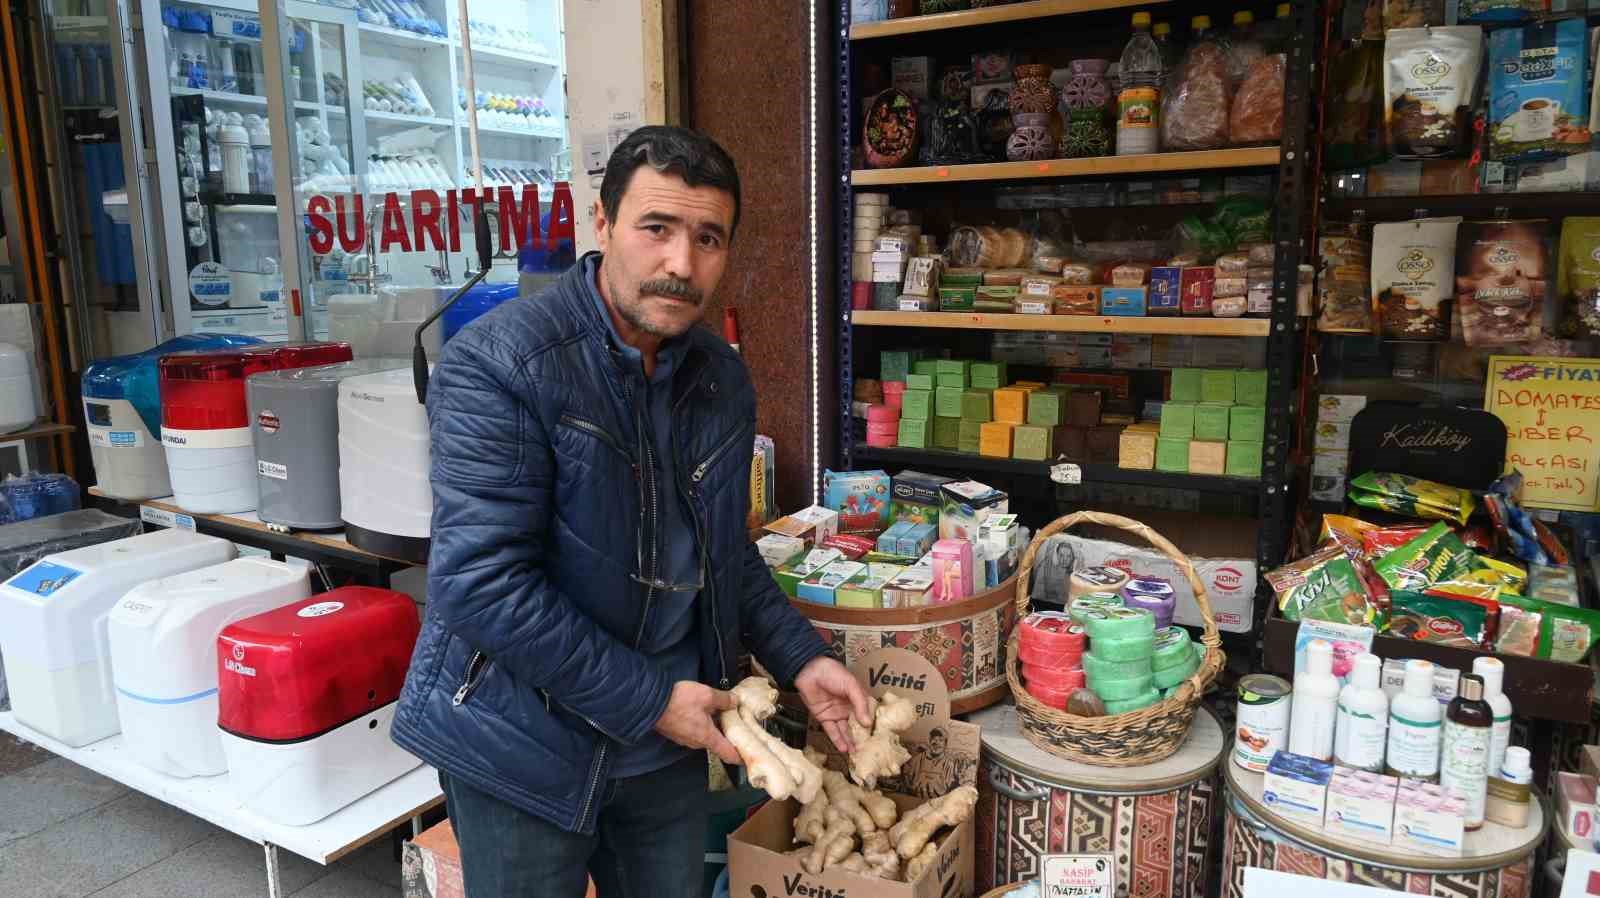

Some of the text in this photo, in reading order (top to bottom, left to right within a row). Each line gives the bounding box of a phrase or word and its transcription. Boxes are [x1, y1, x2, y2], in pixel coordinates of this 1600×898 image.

[307, 181, 577, 254] SU ARITMA
[1216, 573, 1241, 584] KONT
[868, 662, 927, 692] Veritá
